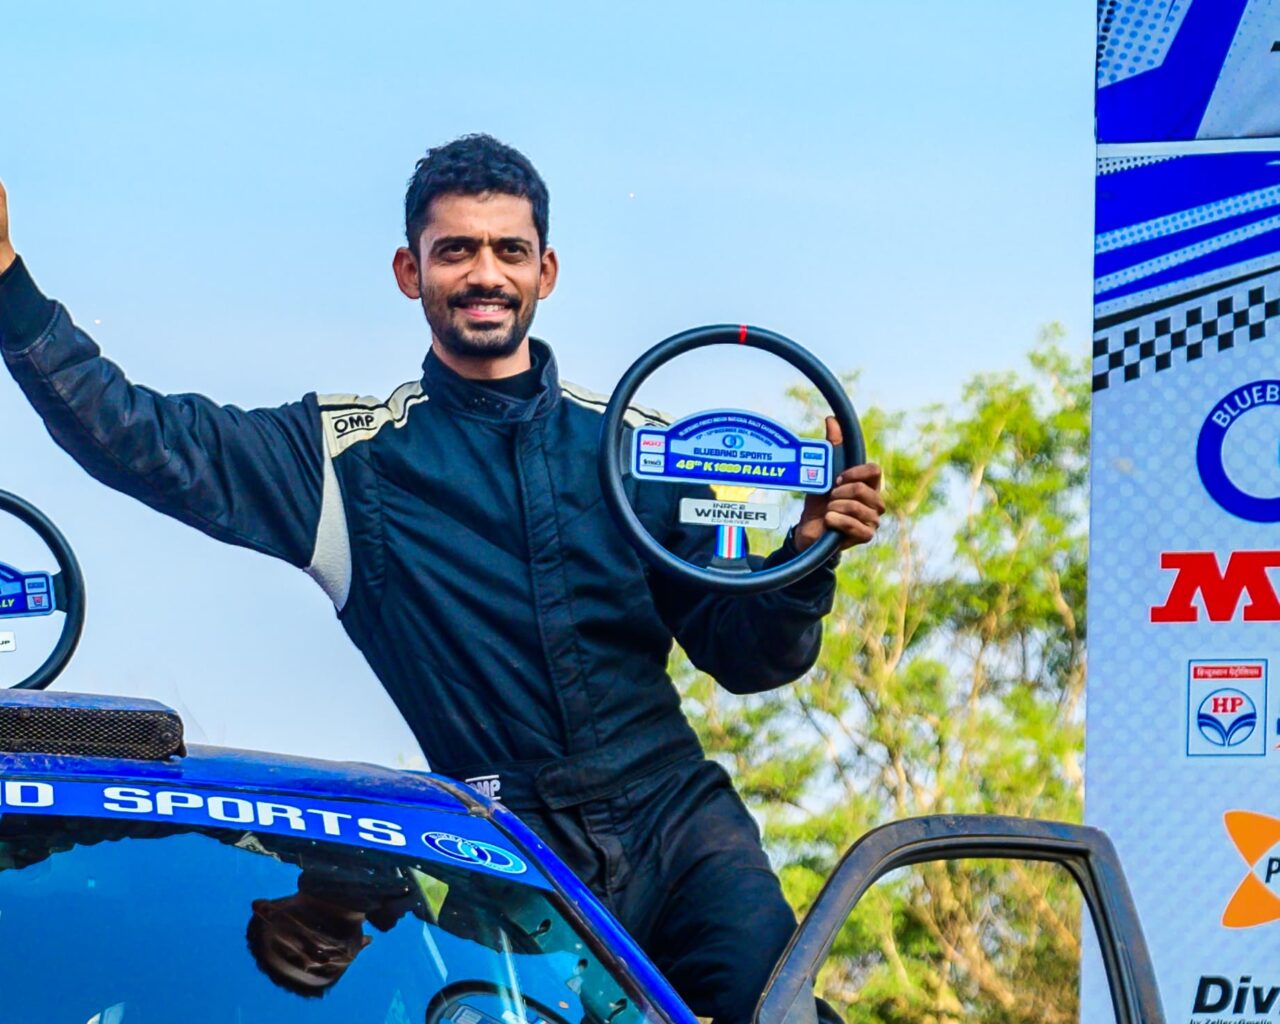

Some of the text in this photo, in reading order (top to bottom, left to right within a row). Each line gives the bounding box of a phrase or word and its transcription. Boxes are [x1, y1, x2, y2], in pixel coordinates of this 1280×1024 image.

[1212, 383, 1280, 428] BLUEB
[334, 415, 375, 434] OMP
[693, 447, 772, 461] BLUEBAND SPORTS
[742, 464, 787, 479] RALLY
[694, 507, 767, 522] WINNER
[1212, 697, 1244, 713] HP
[103, 786, 406, 847] SPORTS
[1192, 976, 1280, 1014] Div
